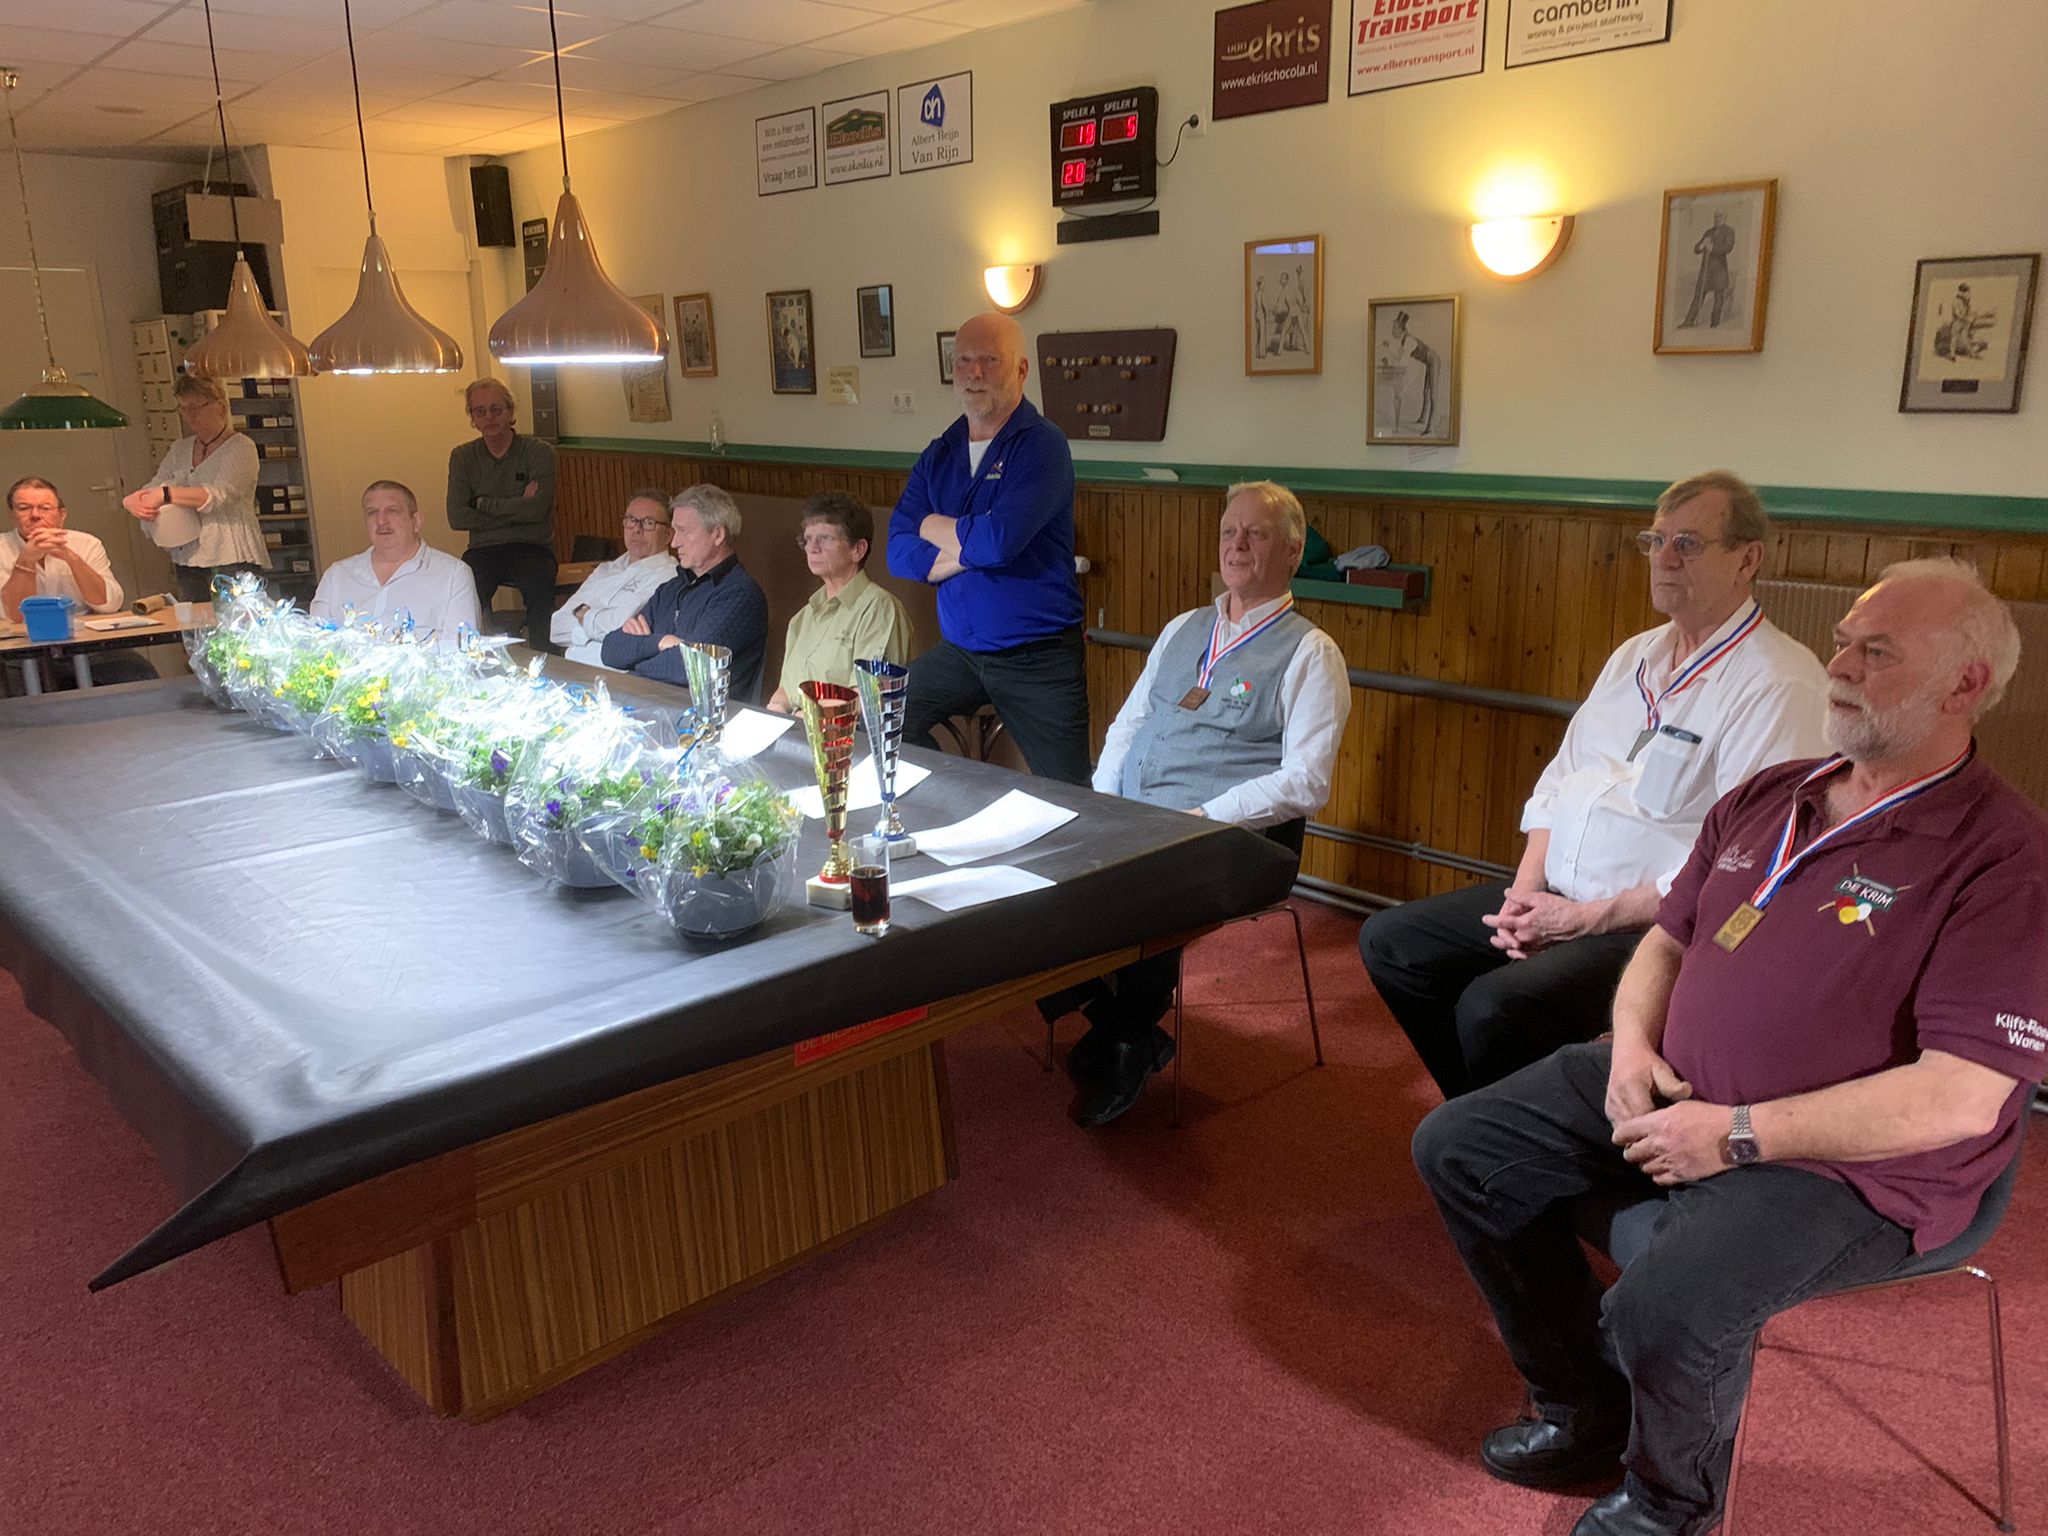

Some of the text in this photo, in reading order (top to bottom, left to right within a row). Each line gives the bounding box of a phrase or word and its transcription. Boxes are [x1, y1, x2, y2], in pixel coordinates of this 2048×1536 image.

[1357, 0, 1480, 45] Transport
[1527, 27, 1557, 40] woning
[1558, 25, 1565, 34] &
[1566, 19, 1598, 34] project
[1247, 15, 1321, 63] ekris
[1356, 44, 1475, 76] www.elberstransport.nl
[1220, 60, 1318, 91] www.ekrischocola.nl
[1062, 105, 1096, 121] SPELER A
[1103, 100, 1130, 113] SPELER
[911, 128, 960, 147] Albert Heijn
[1079, 122, 1095, 145] 19
[1126, 116, 1136, 138] 5
[911, 144, 960, 164] Van Rijn
[763, 172, 783, 185] Vraag
[1064, 162, 1084, 184] 20
[1839, 879, 1862, 894] DE
[1859, 886, 1894, 908] KRIM
